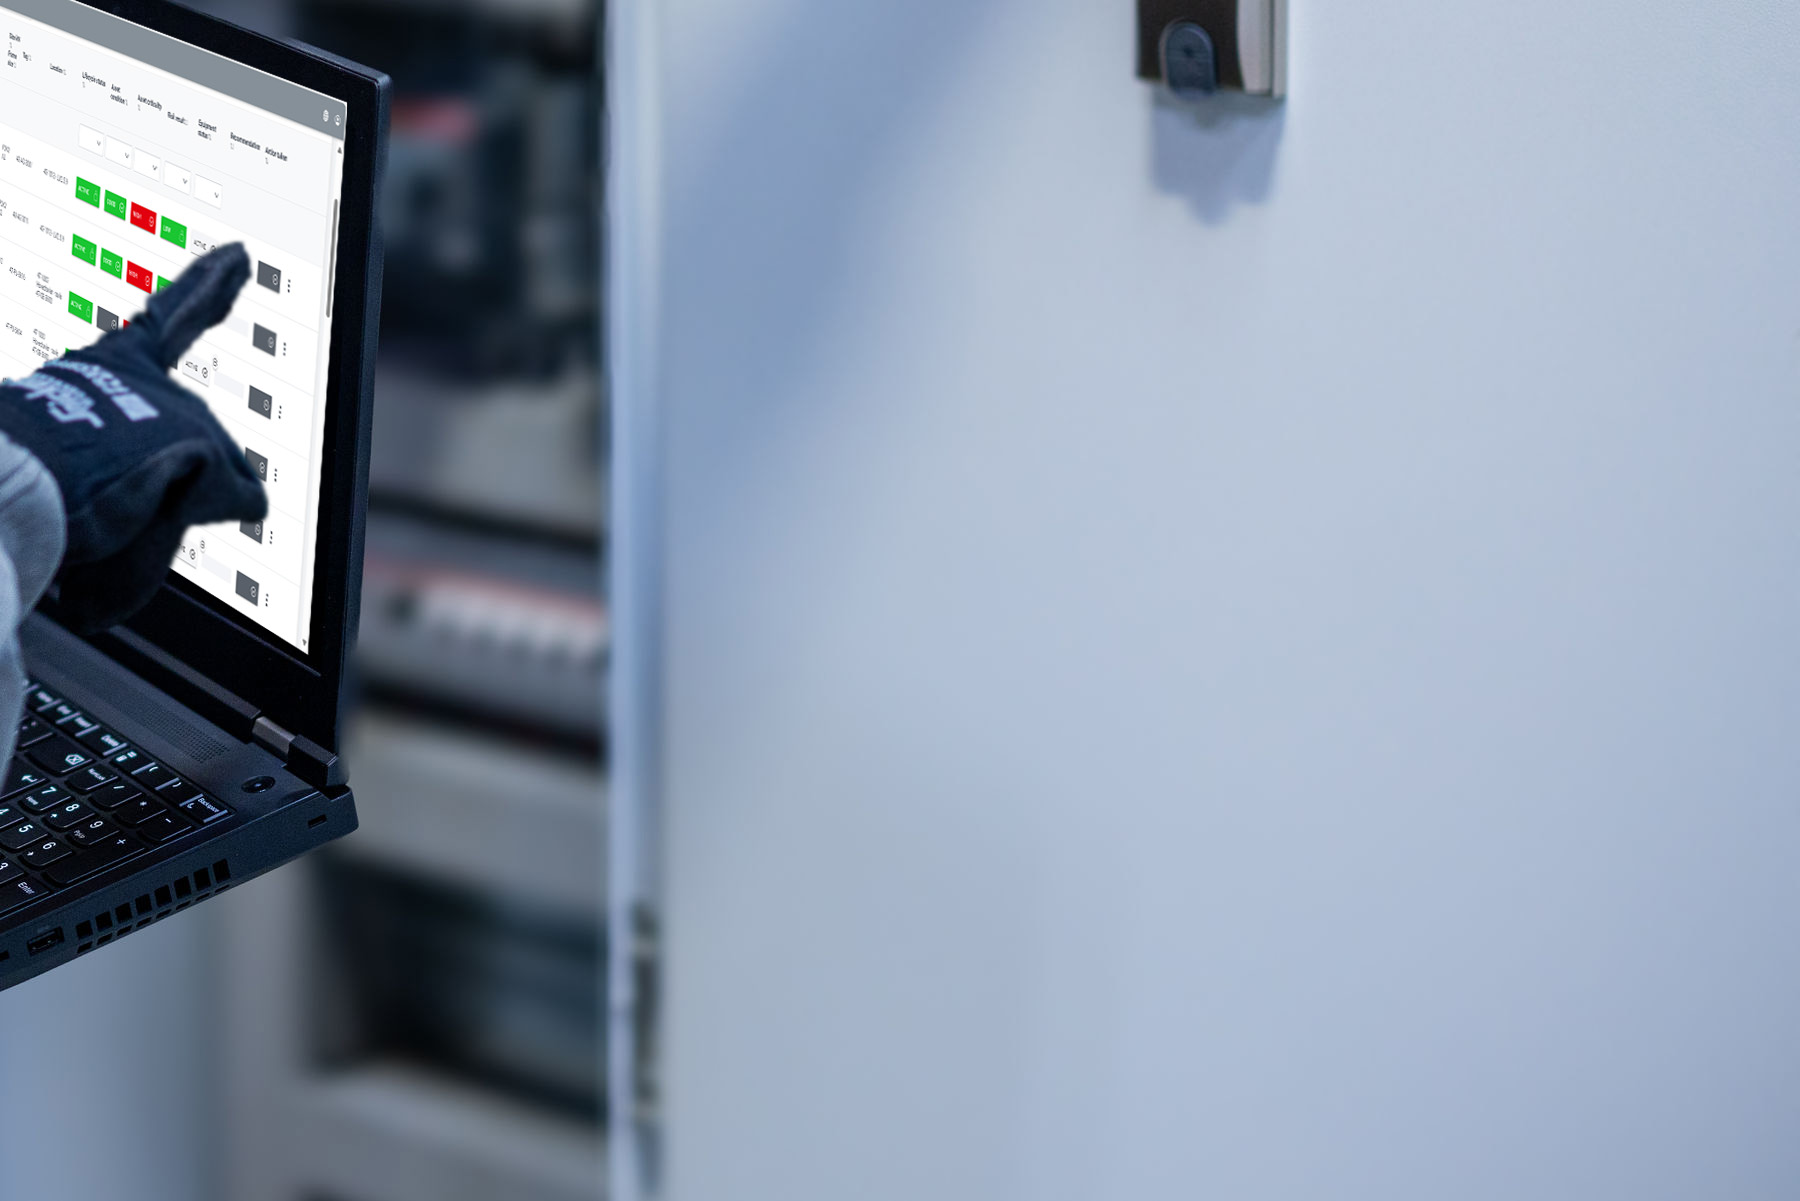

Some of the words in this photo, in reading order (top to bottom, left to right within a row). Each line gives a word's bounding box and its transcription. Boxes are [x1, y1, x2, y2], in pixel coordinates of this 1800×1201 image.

[41, 786, 57, 794] 7
[66, 804, 80, 812] 8
[19, 824, 33, 832] 5
[90, 820, 104, 828] 9
[43, 841, 56, 850] 6
[18, 881, 35, 894] Enter
